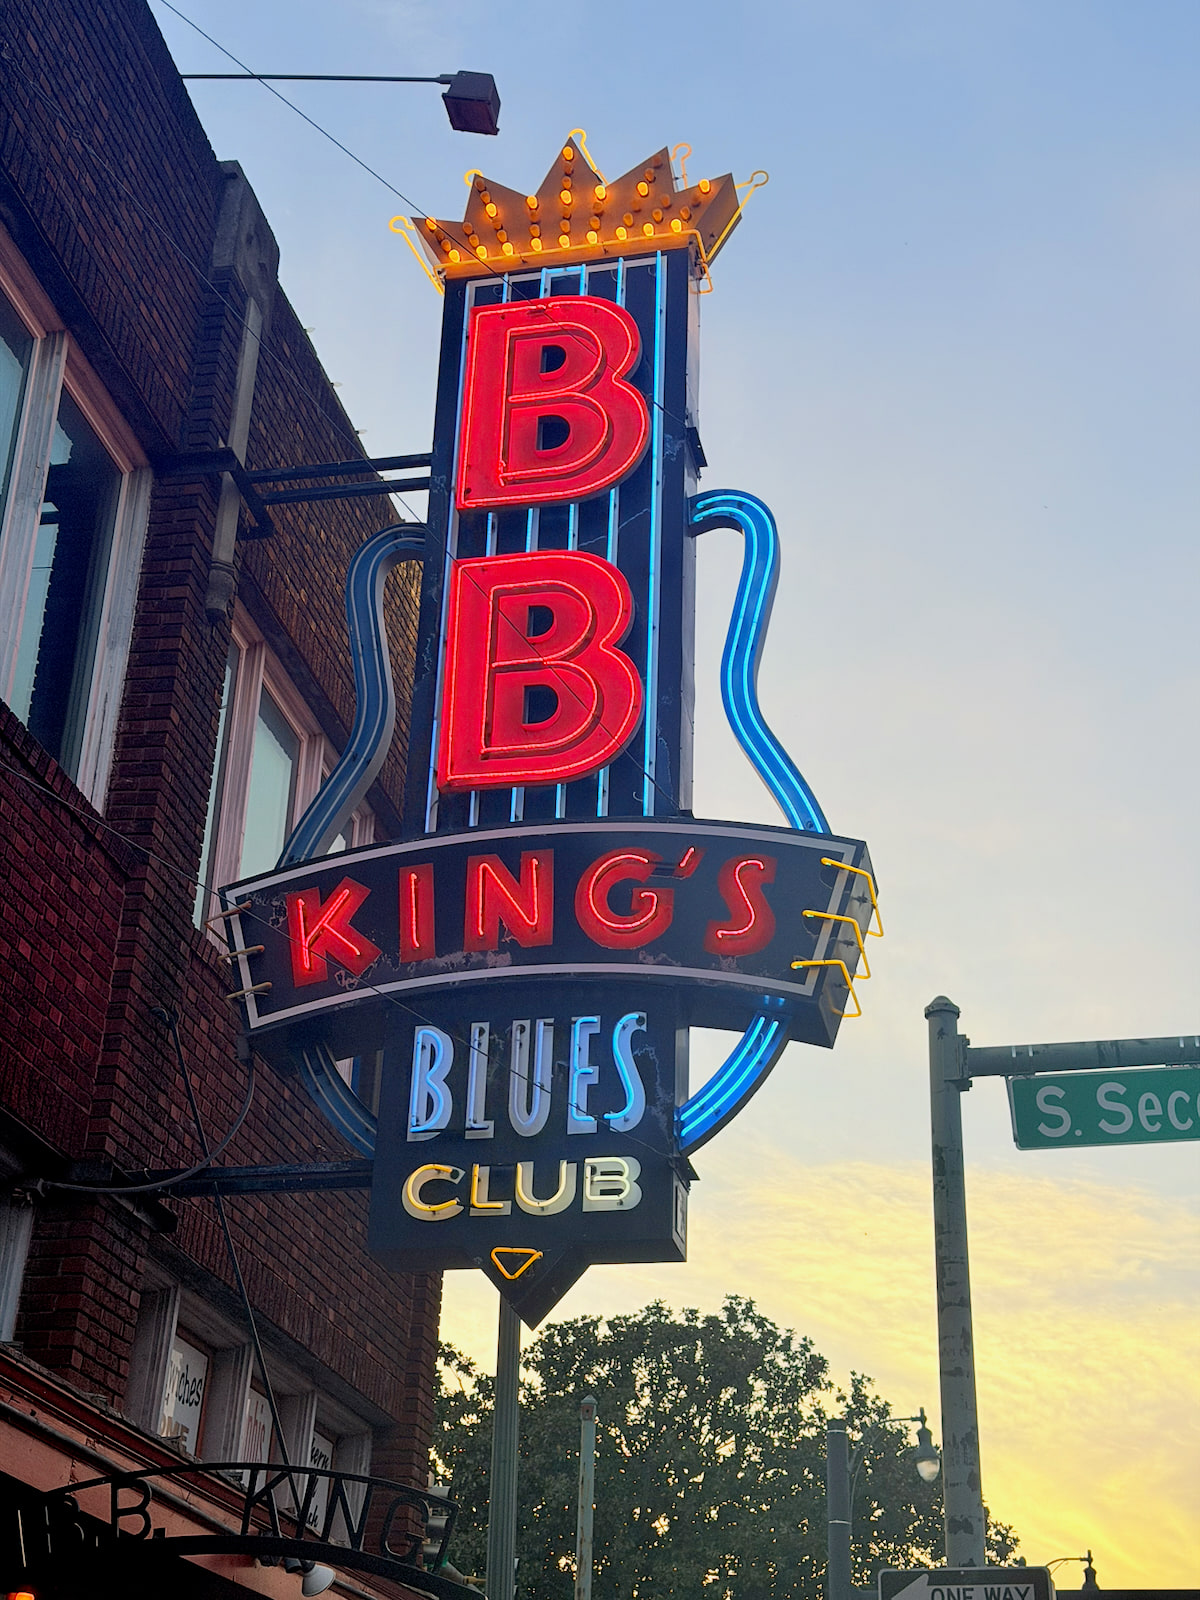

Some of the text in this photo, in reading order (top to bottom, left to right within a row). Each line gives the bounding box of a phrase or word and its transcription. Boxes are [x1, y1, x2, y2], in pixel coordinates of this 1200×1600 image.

[287, 846, 777, 988] KING'S
[406, 1011, 648, 1142] BLUES
[1036, 1081, 1200, 1138] S. Sec
[401, 1156, 642, 1222] CLUB
[240, 1470, 431, 1562] KING
[930, 1586, 1031, 1600] ONE WAY
